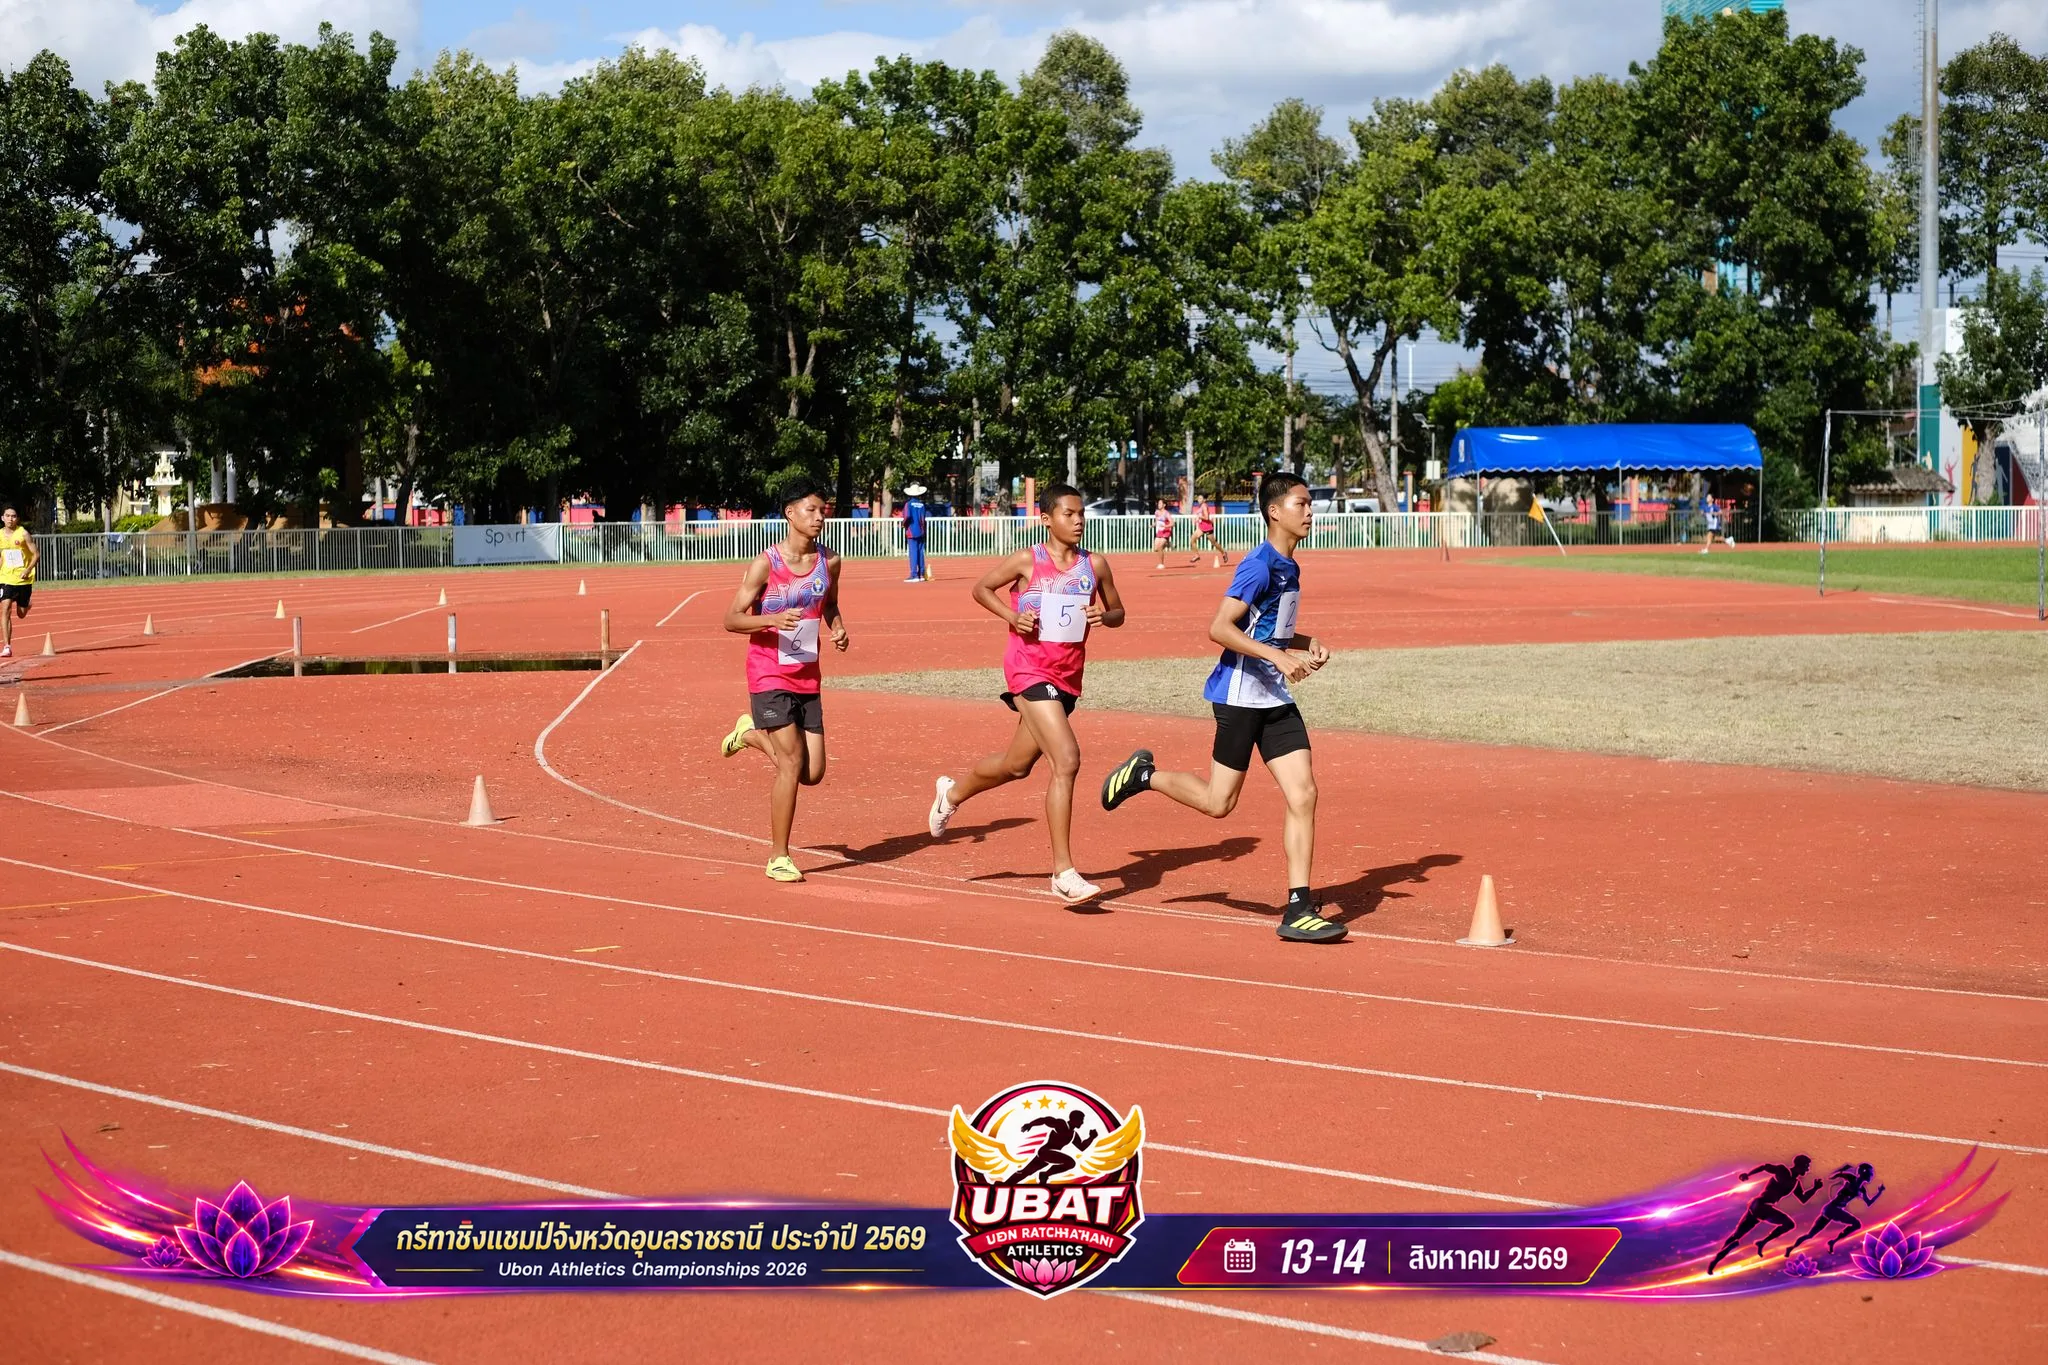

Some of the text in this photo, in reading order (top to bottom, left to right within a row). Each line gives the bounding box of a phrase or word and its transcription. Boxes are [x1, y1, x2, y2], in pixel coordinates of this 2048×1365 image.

[485, 528, 526, 547] Sprt
[1058, 604, 1075, 628] 5
[1286, 601, 1296, 628] 2
[790, 626, 804, 651] 6
